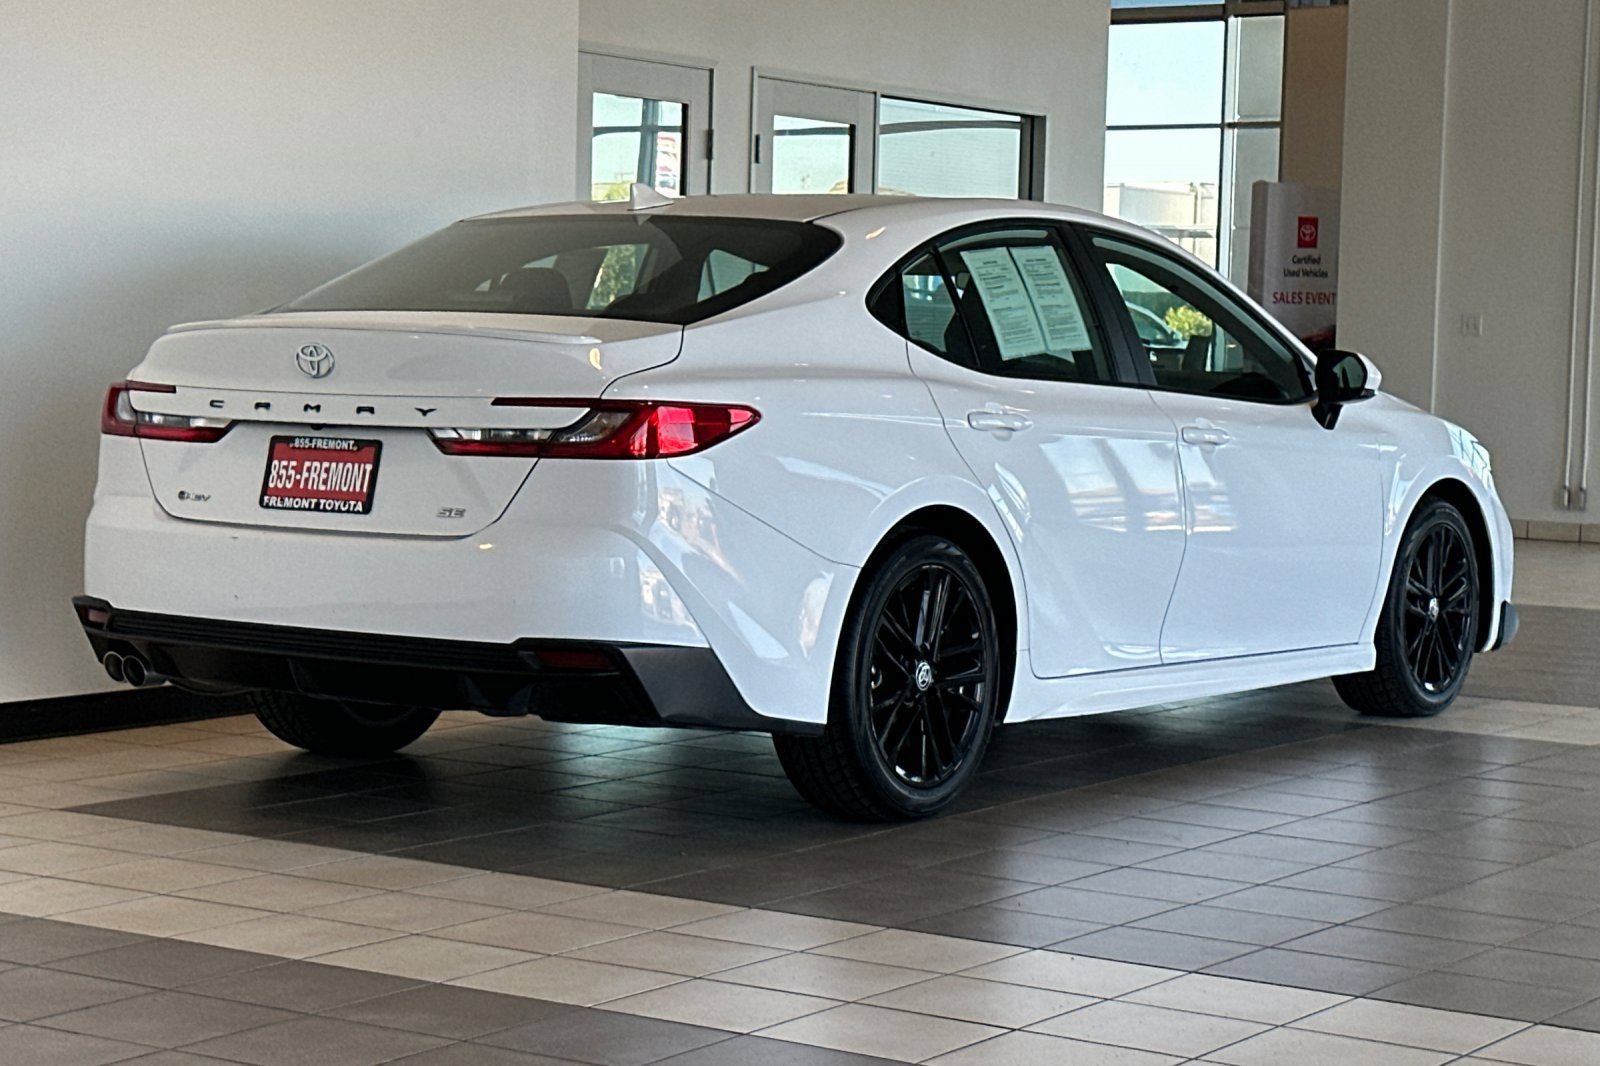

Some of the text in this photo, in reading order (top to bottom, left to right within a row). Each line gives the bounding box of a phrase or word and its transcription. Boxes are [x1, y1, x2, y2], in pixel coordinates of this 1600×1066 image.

[1292, 255, 1321, 264] Certified
[1283, 268, 1328, 278] Used Vehicles
[1273, 292, 1336, 305] SALES EVENT
[209, 400, 437, 416] CAMRY
[294, 438, 354, 450] 855-FREMONT
[268, 459, 373, 493] 855-FREMONT
[319, 499, 363, 512] TOYOTA
[436, 507, 466, 518] SE
